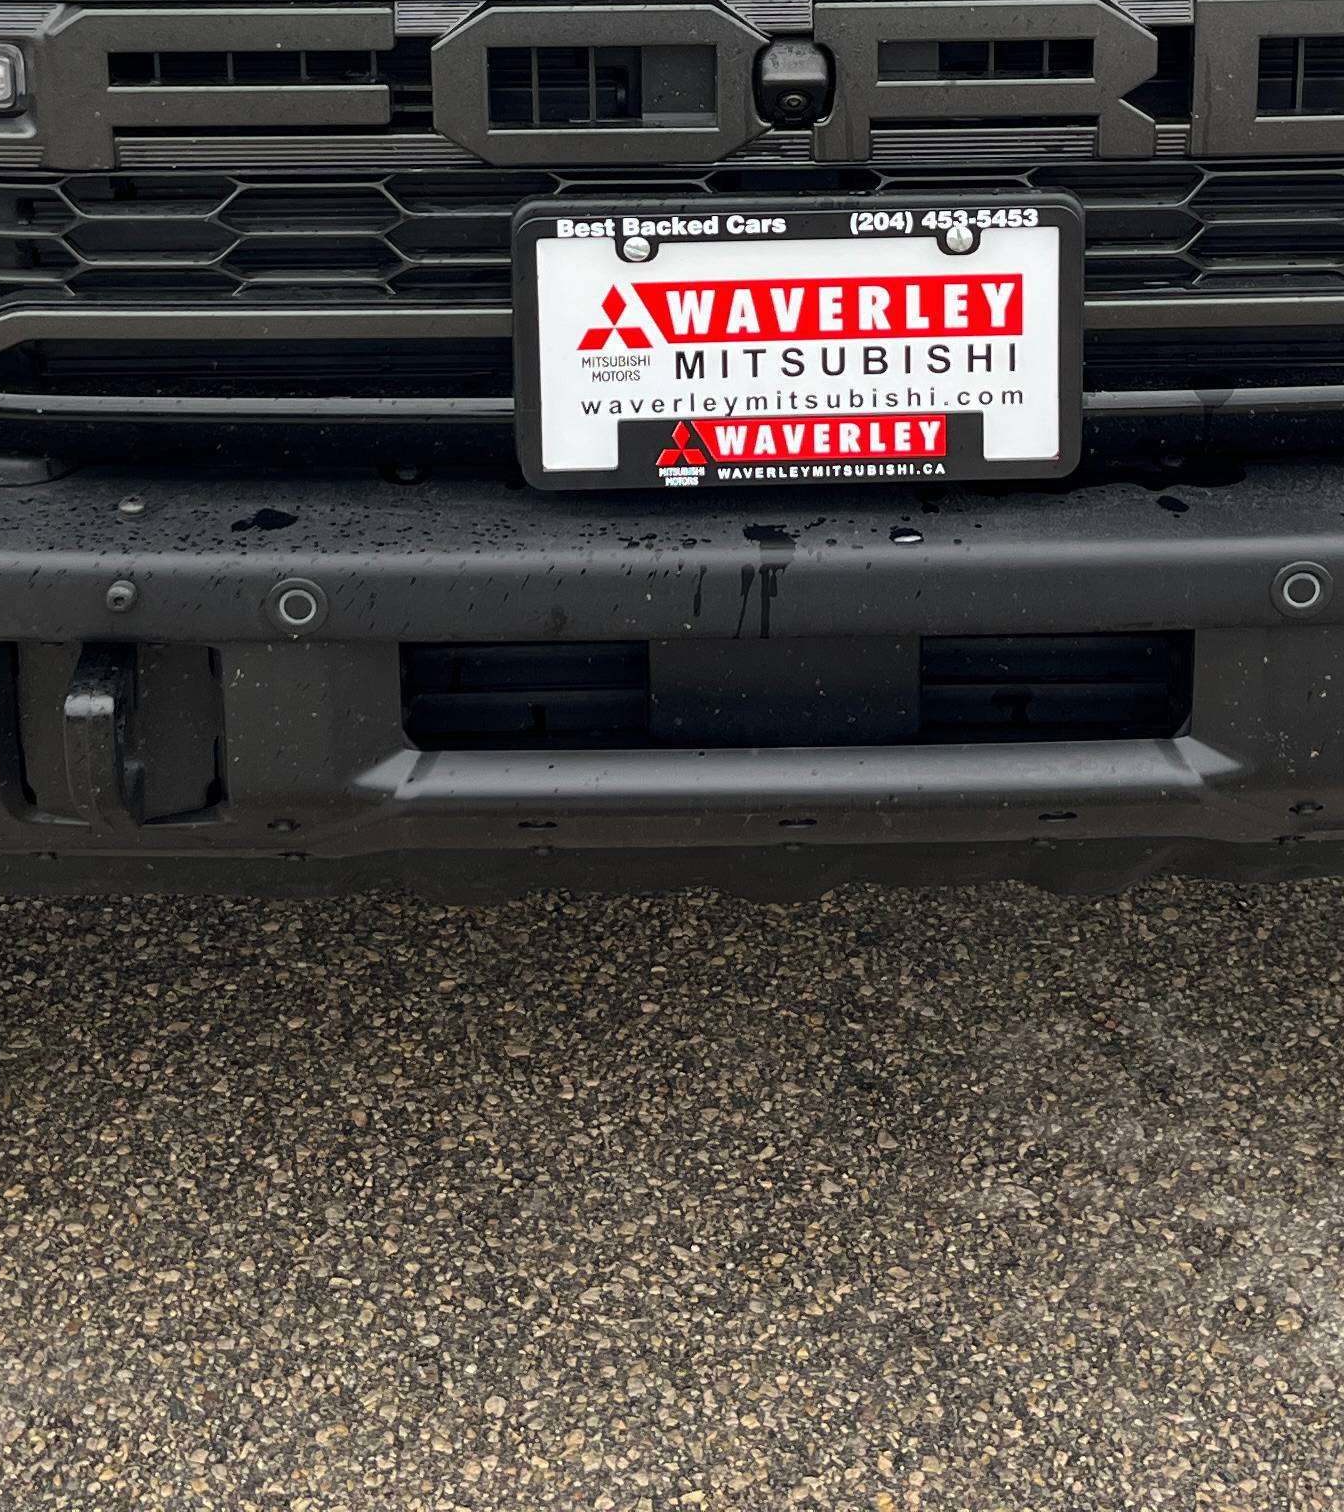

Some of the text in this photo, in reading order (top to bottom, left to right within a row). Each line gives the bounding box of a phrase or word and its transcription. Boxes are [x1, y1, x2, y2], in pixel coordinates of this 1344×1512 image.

[556, 208, 1039, 238] Best Backed Cars (204) 453-5453
[665, 282, 1016, 336] WAVERLEY
[581, 355, 651, 369] MITSUBISHI
[591, 369, 641, 383] MOTORS
[674, 343, 1016, 380] MITSUBISHI
[580, 385, 1024, 416] waverleymitsubishi.com
[714, 420, 942, 457] WAVERLEY
[717, 463, 947, 481] WAVERLEYMITSUBISHI.CA
